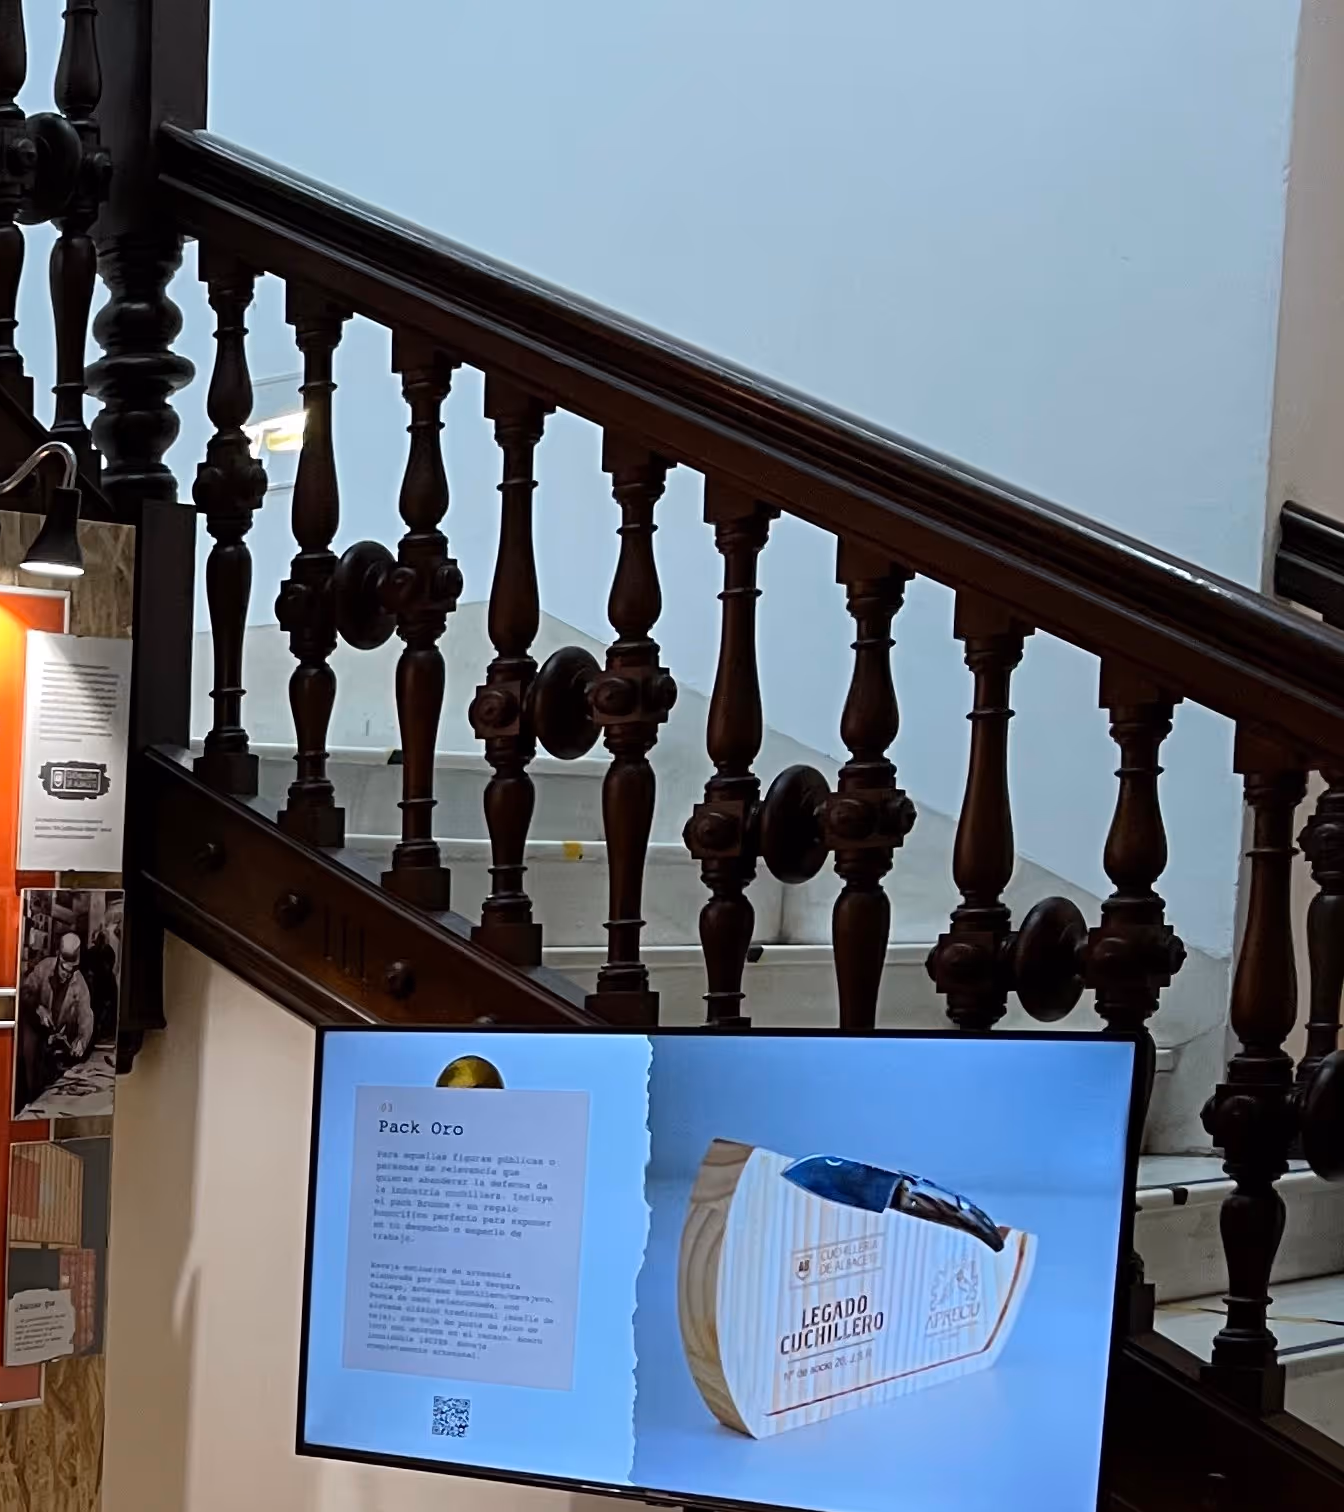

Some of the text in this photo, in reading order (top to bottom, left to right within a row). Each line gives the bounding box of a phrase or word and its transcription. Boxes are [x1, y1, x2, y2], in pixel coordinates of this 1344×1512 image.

[379, 1120, 464, 1136] Pack Oro
[802, 1295, 868, 1329] LEGADO
[780, 1311, 884, 1355] CUCHILLERO
